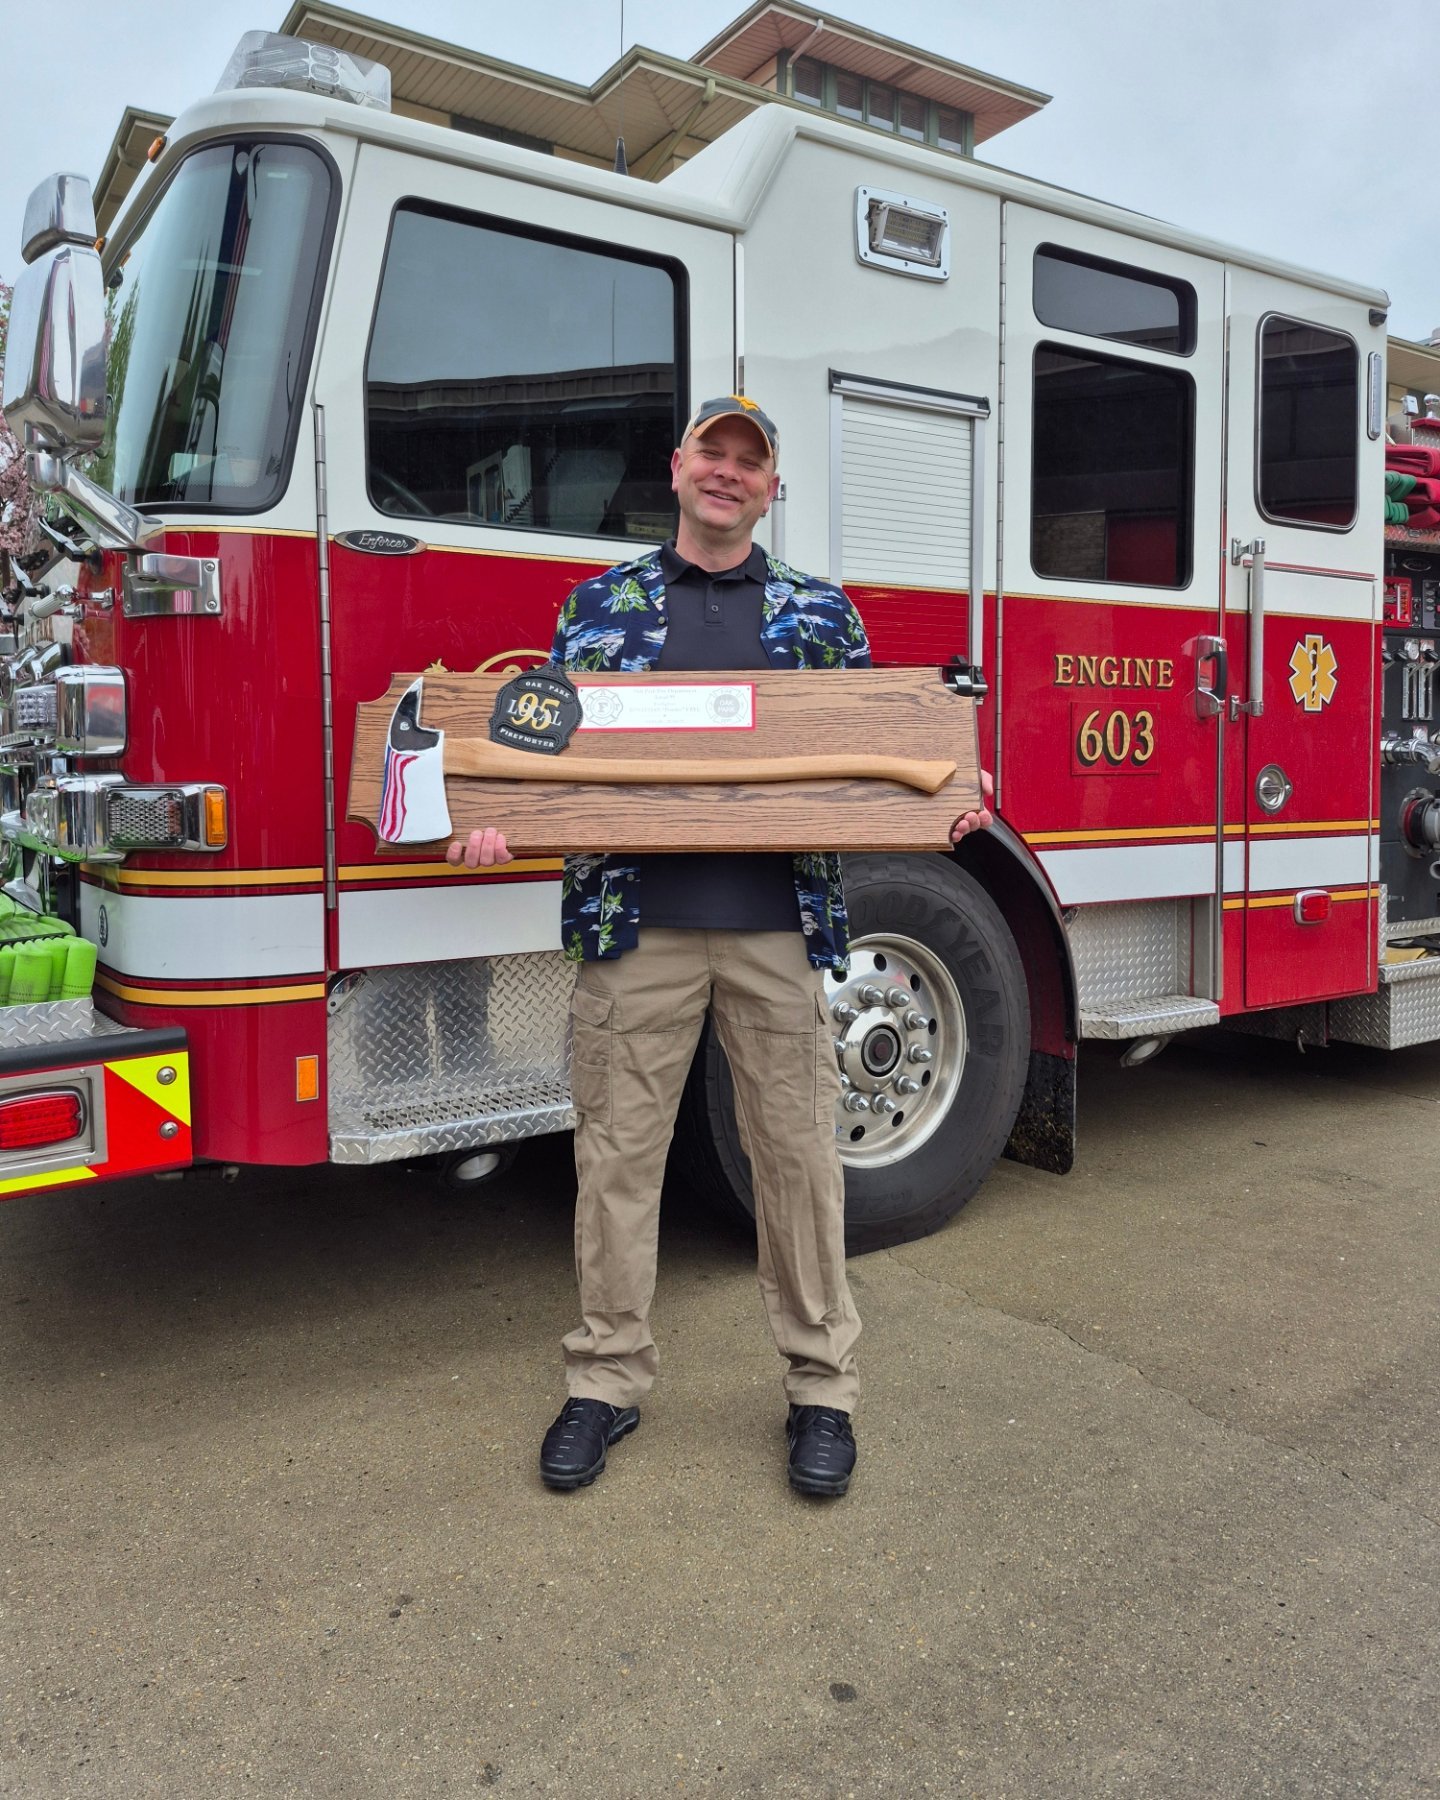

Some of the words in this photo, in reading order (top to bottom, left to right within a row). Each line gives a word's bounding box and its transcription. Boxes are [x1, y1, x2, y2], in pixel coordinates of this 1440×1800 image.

[358, 533, 409, 550] Enforcer
[1054, 654, 1174, 689] ENGINE
[549, 685, 570, 698] PARK
[507, 699, 562, 726] LOCAL
[511, 692, 561, 731] 95
[500, 727, 555, 748] FIREFIGHTER
[1078, 709, 1154, 766] 603
